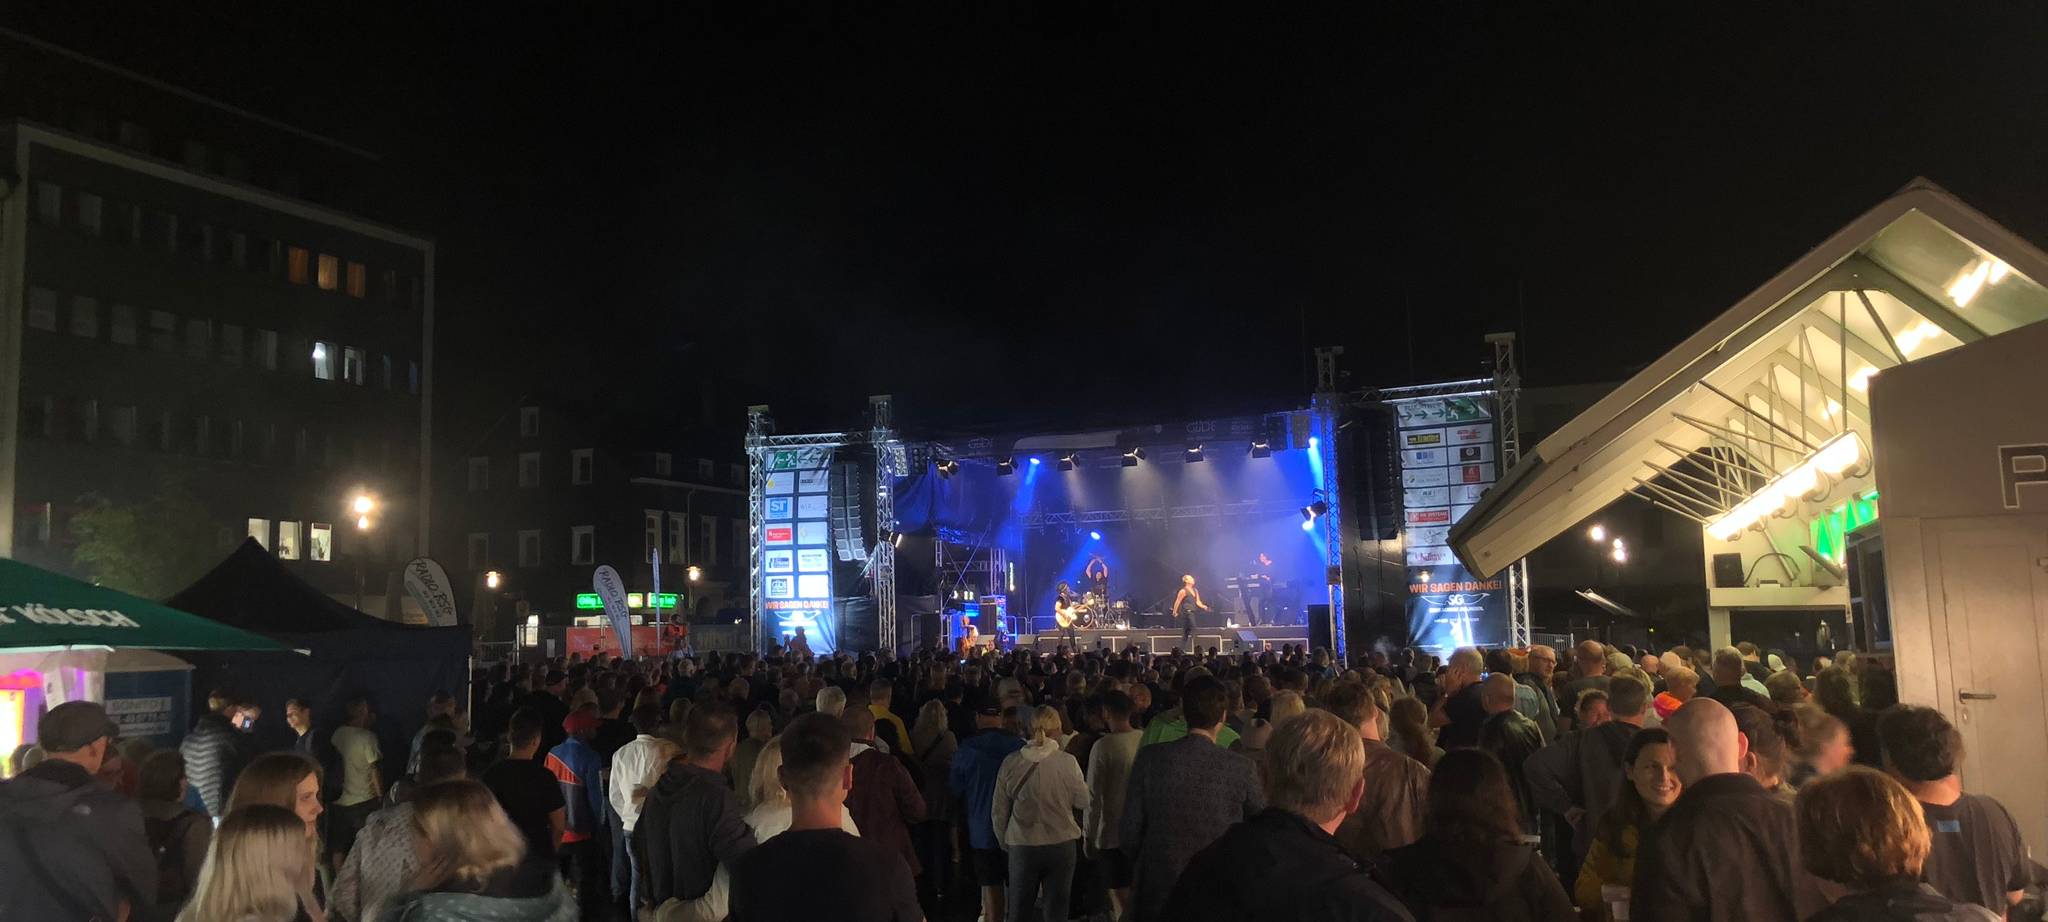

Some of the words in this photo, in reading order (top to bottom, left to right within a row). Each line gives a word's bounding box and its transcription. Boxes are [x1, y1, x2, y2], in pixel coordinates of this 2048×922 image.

[1409, 583, 1429, 593] WIR
[1430, 582, 1463, 593] SAGEN
[1465, 580, 1503, 592] DANKE!
